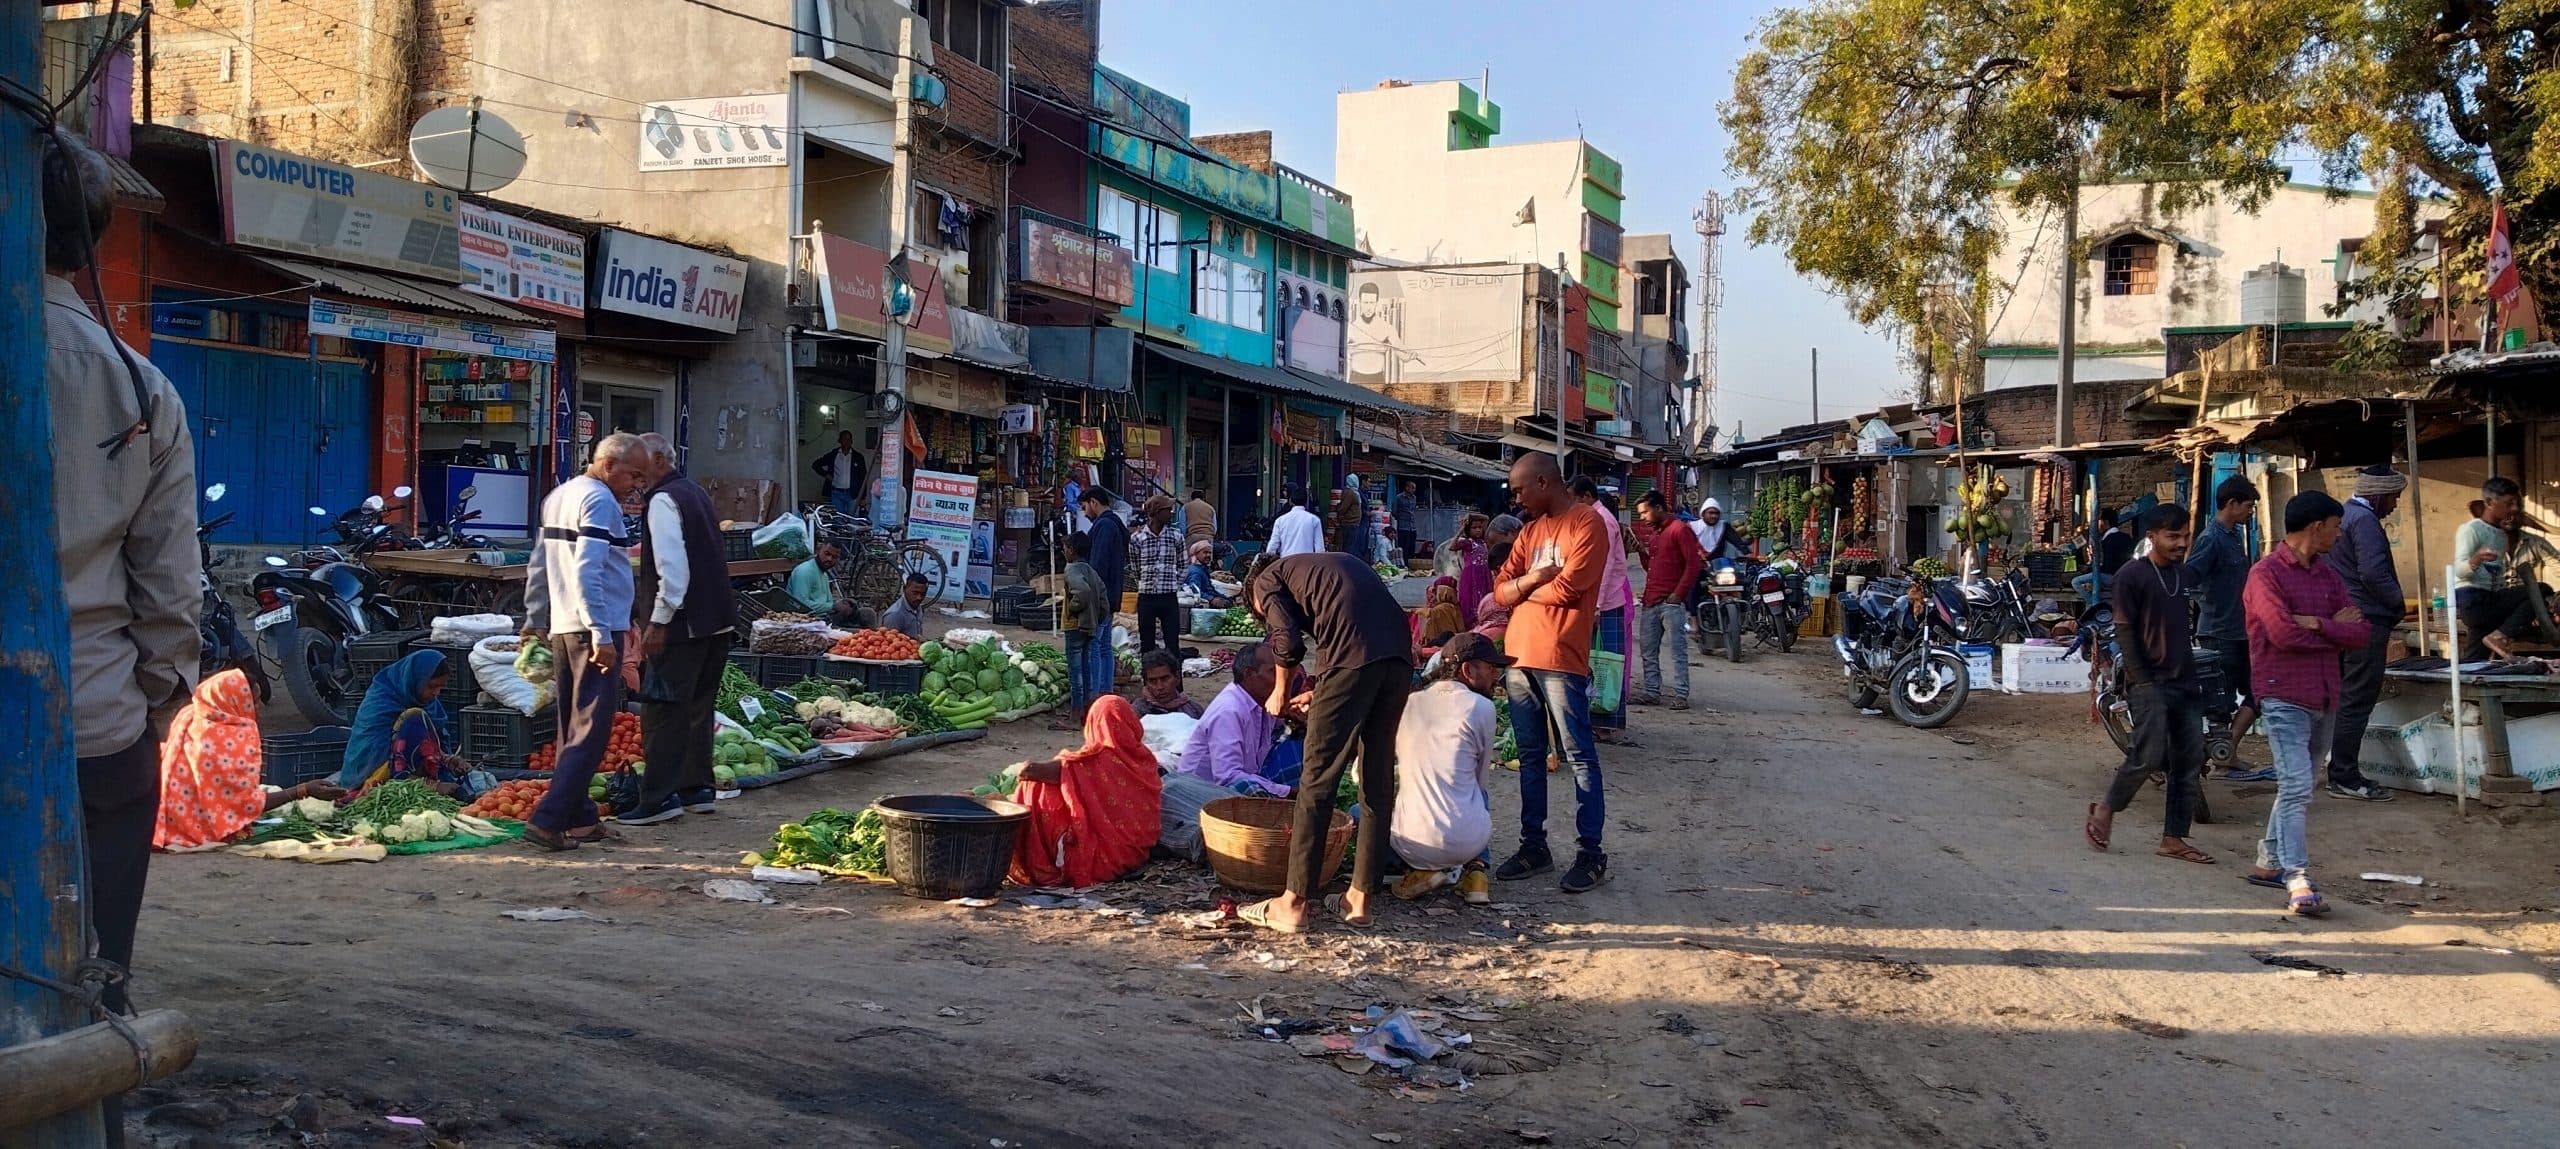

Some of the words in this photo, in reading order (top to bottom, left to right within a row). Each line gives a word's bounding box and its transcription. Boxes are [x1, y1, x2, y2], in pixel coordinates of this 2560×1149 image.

[709, 100, 768, 121] Ajanta
[693, 157, 723, 166] RANJEET
[727, 156, 746, 164] SHOE
[748, 154, 773, 163] HOUSE
[236, 149, 355, 198] COMPUTER
[461, 211, 504, 237] VISHAL
[507, 223, 582, 257] ENTERPRISES
[608, 257, 678, 309] india
[696, 288, 739, 322] ATM
[915, 479, 934, 489] लोन
[958, 502, 969, 512] पर
